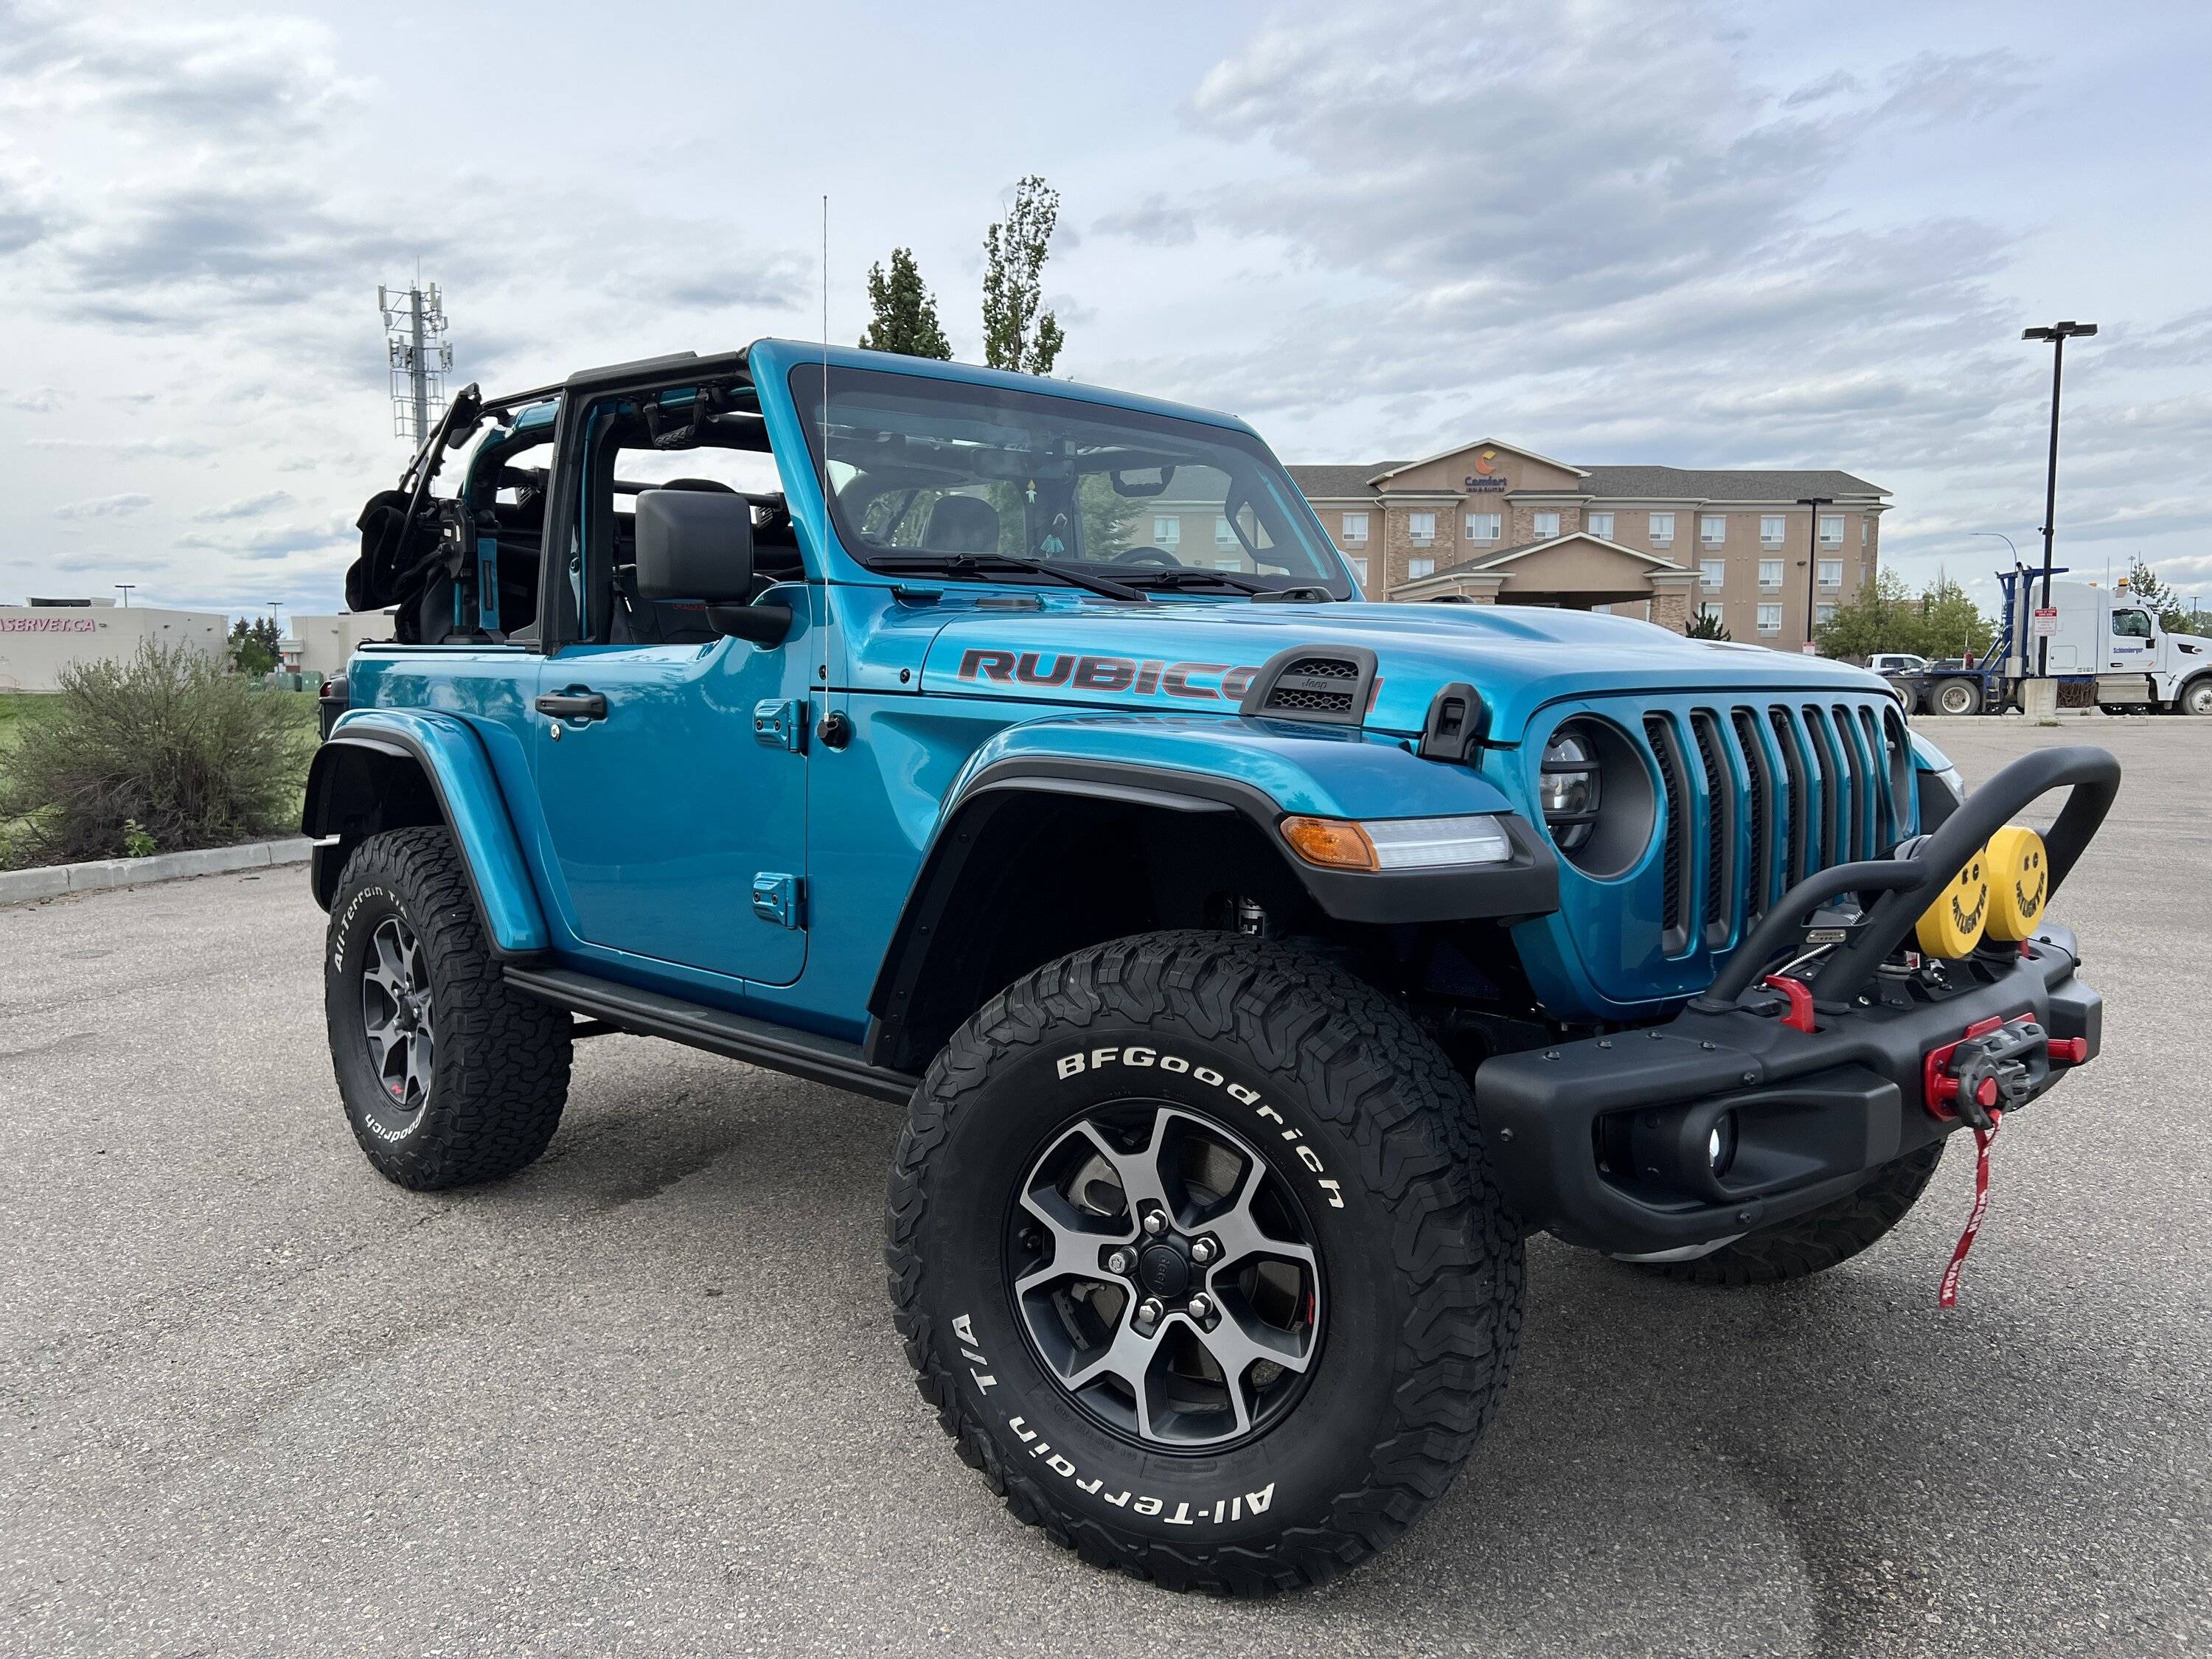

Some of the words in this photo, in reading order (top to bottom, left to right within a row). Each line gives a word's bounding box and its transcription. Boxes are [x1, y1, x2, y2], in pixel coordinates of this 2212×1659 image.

[1464, 476, 1507, 487] Comfort
[1301, 678, 1328, 690] Jeep
[334, 886, 383, 974] All-Terrain
[1056, 1046, 1345, 1209] BFGoodrich
[1941, 1258, 1963, 1301] WARN
[951, 1313, 998, 1397] T/A
[1009, 1416, 1276, 1525] All-Terrain
